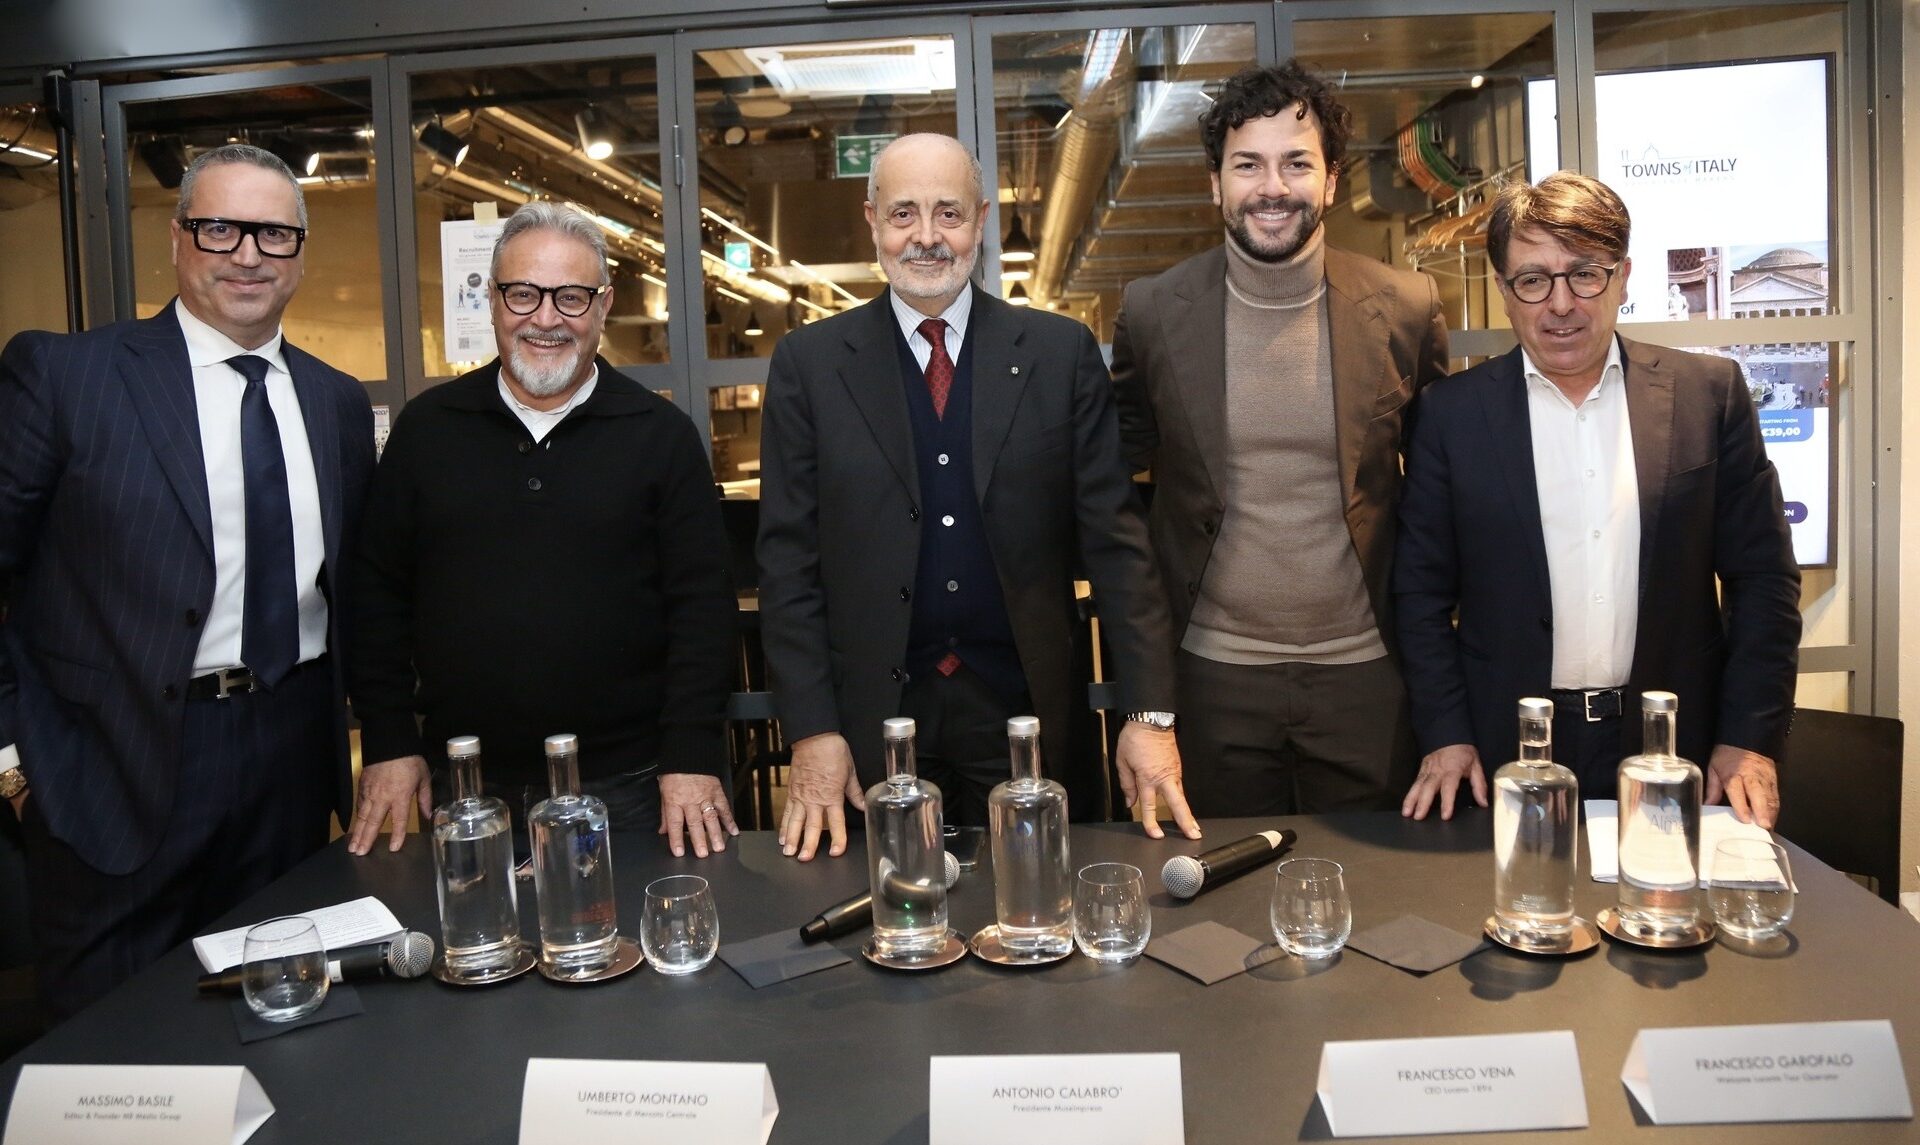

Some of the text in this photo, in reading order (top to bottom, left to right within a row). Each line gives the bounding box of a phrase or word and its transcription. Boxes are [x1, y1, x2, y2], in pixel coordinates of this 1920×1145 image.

[1621, 161, 1682, 178] TOWNS
[1695, 158, 1738, 174] ITALY
[1620, 302, 1636, 315] of
[1696, 1053, 1854, 1070] FRANCESCO GAROFALO
[1397, 1066, 1516, 1081] FRANCESCO VENA
[992, 1086, 1123, 1099] ANTONIO CALABRO'
[1424, 1086, 1442, 1095] CEO
[77, 1095, 175, 1107] MASSIMO BASILE
[577, 1090, 709, 1107] UMBERTO MONTANO
[586, 1108, 623, 1117] Presidente
[1012, 1104, 1052, 1112] Presidente
[93, 1112, 121, 1120] Founder
